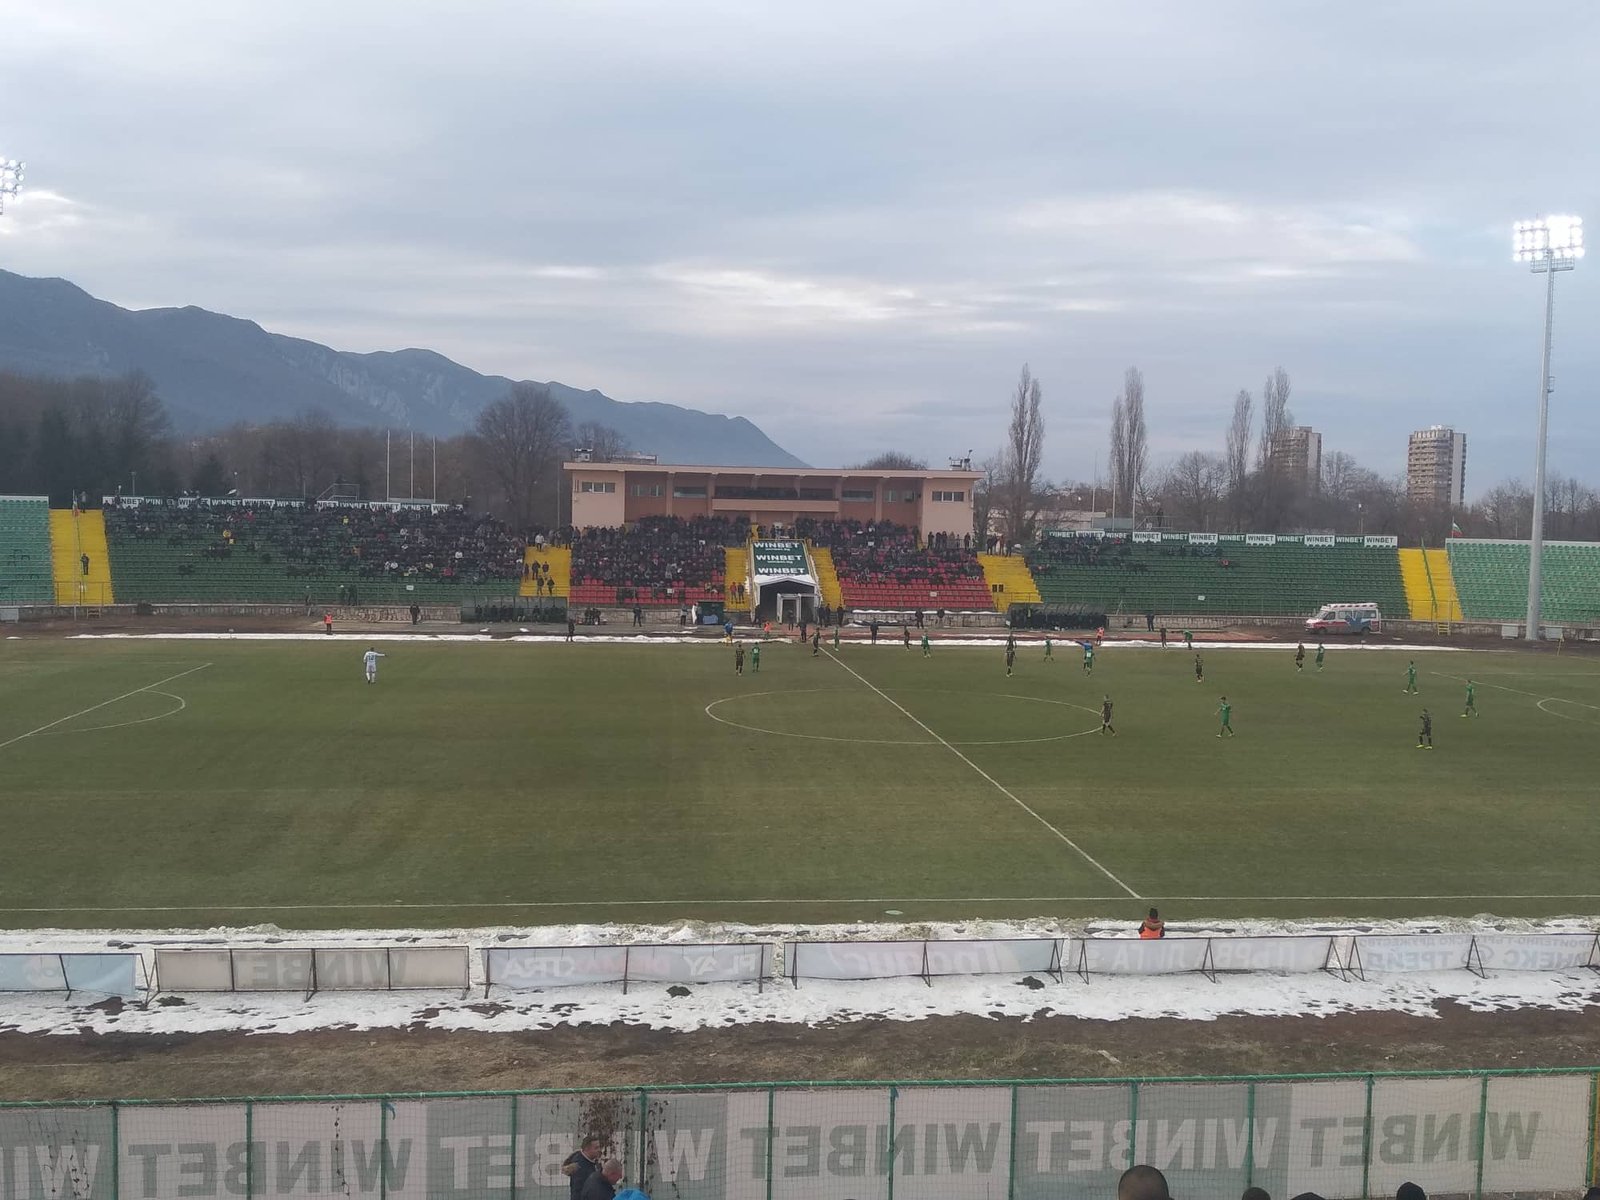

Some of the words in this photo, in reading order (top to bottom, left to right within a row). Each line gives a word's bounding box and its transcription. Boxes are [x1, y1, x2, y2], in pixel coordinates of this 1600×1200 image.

[1162, 533, 1188, 541] WINBET
[1190, 534, 1217, 542] WINBET
[1218, 534, 1246, 542] WINBET
[1277, 535, 1304, 543] WINBET
